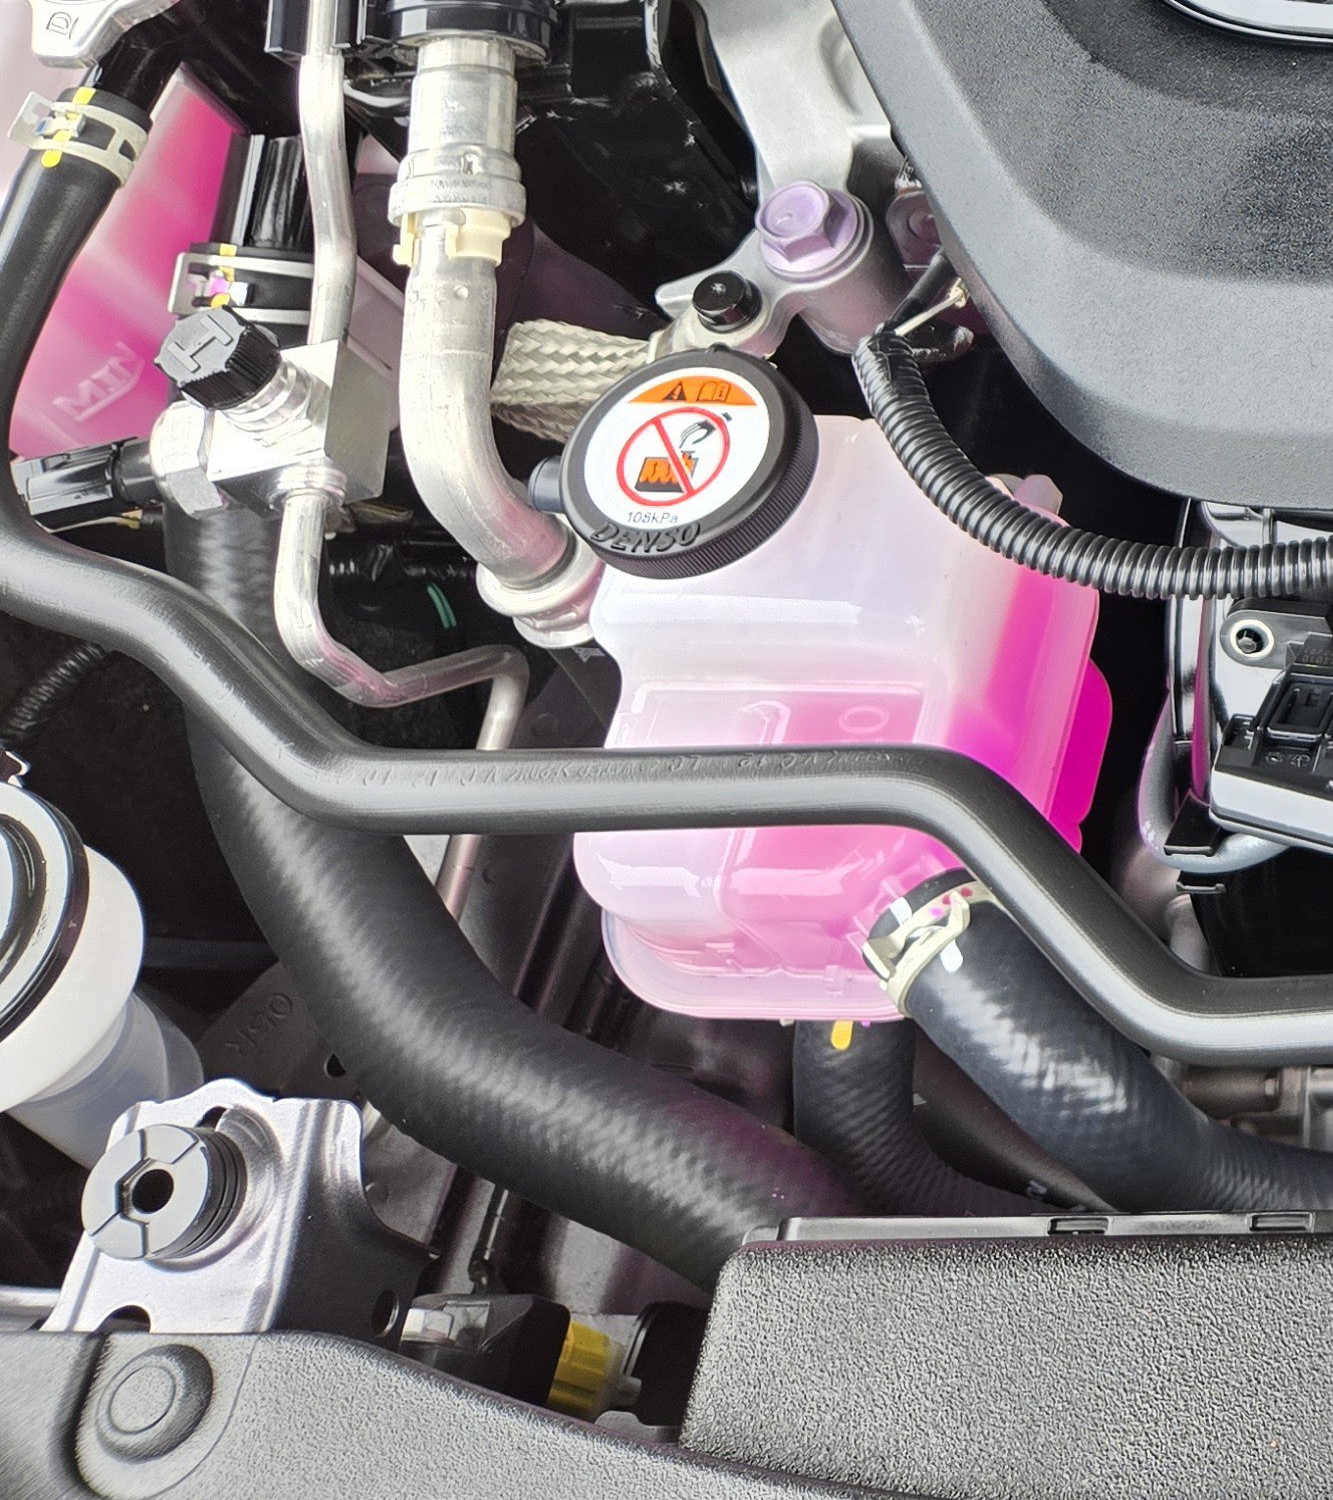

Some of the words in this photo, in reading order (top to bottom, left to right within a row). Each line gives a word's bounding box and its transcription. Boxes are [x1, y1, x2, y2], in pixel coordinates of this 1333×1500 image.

[167, 314, 234, 373] H
[626, 511, 679, 524] 108kPa
[590, 522, 702, 554] DENSO
